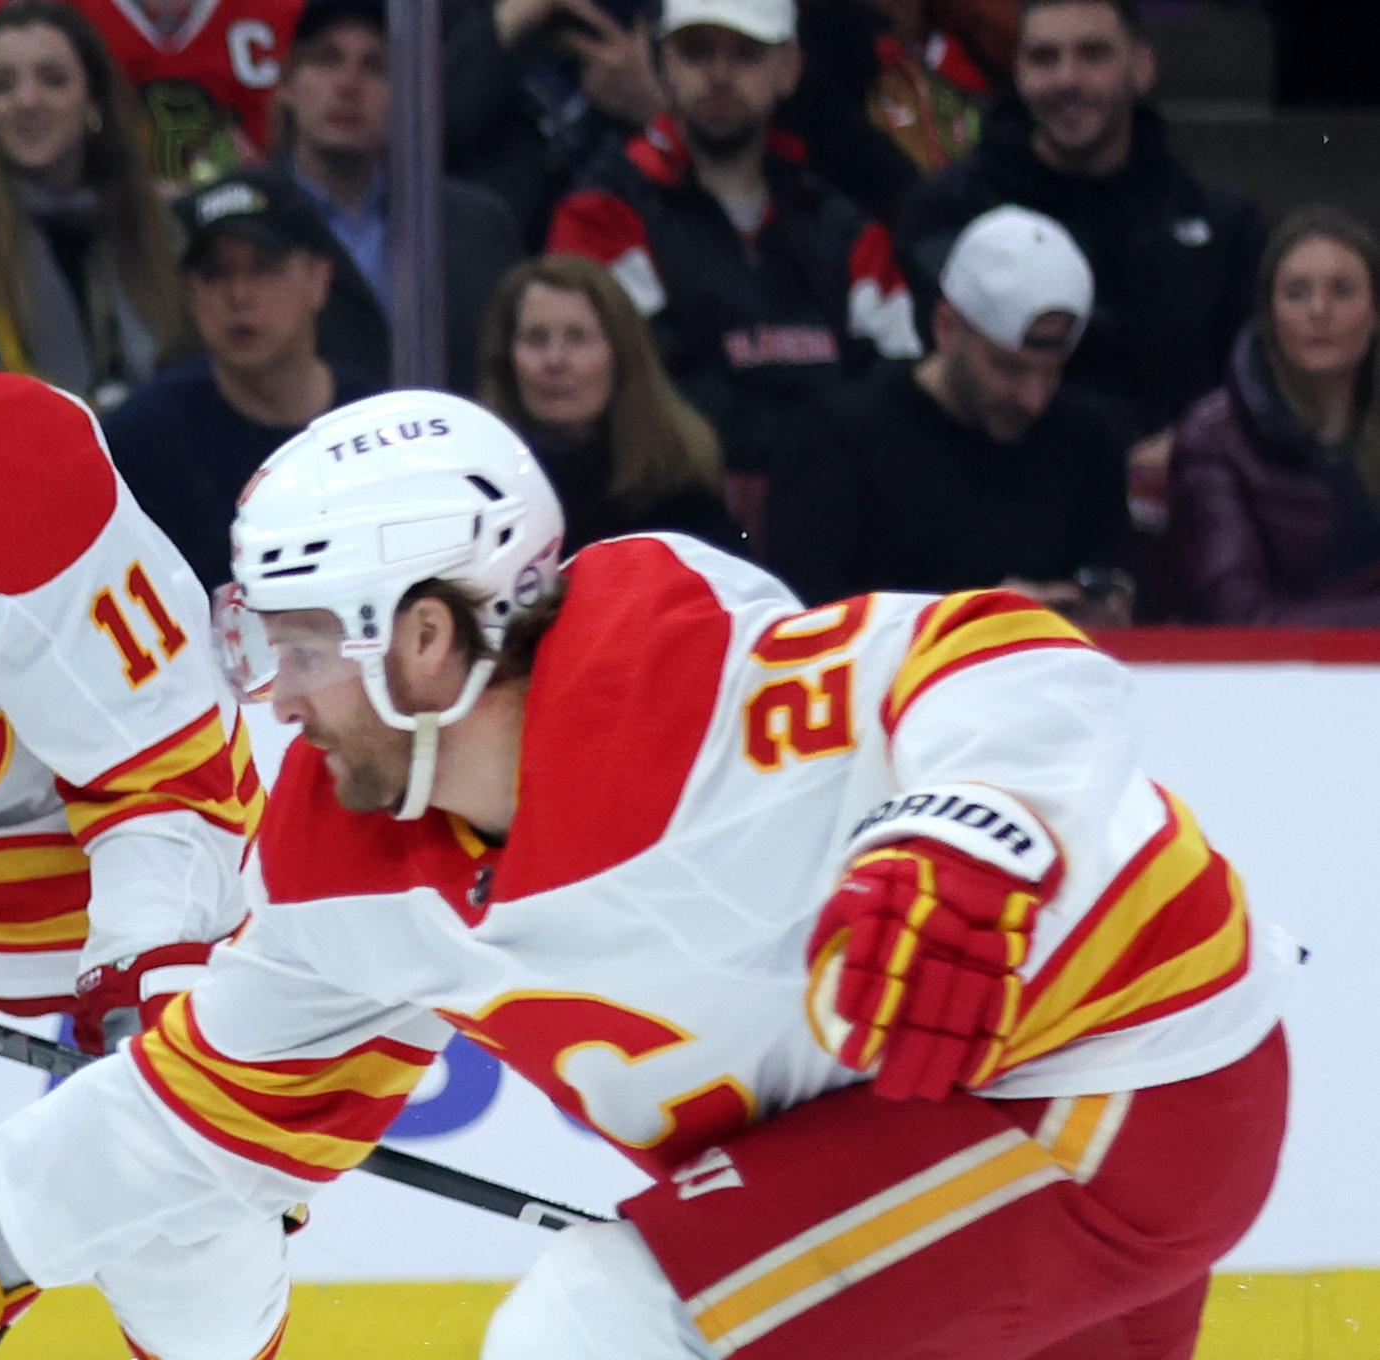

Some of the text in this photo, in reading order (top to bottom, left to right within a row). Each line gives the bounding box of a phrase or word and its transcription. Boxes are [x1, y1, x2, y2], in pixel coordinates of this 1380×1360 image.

[227, 19, 279, 88] C
[327, 419, 450, 462] TELUS
[89, 560, 188, 690] 11
[743, 590, 877, 773] 20
